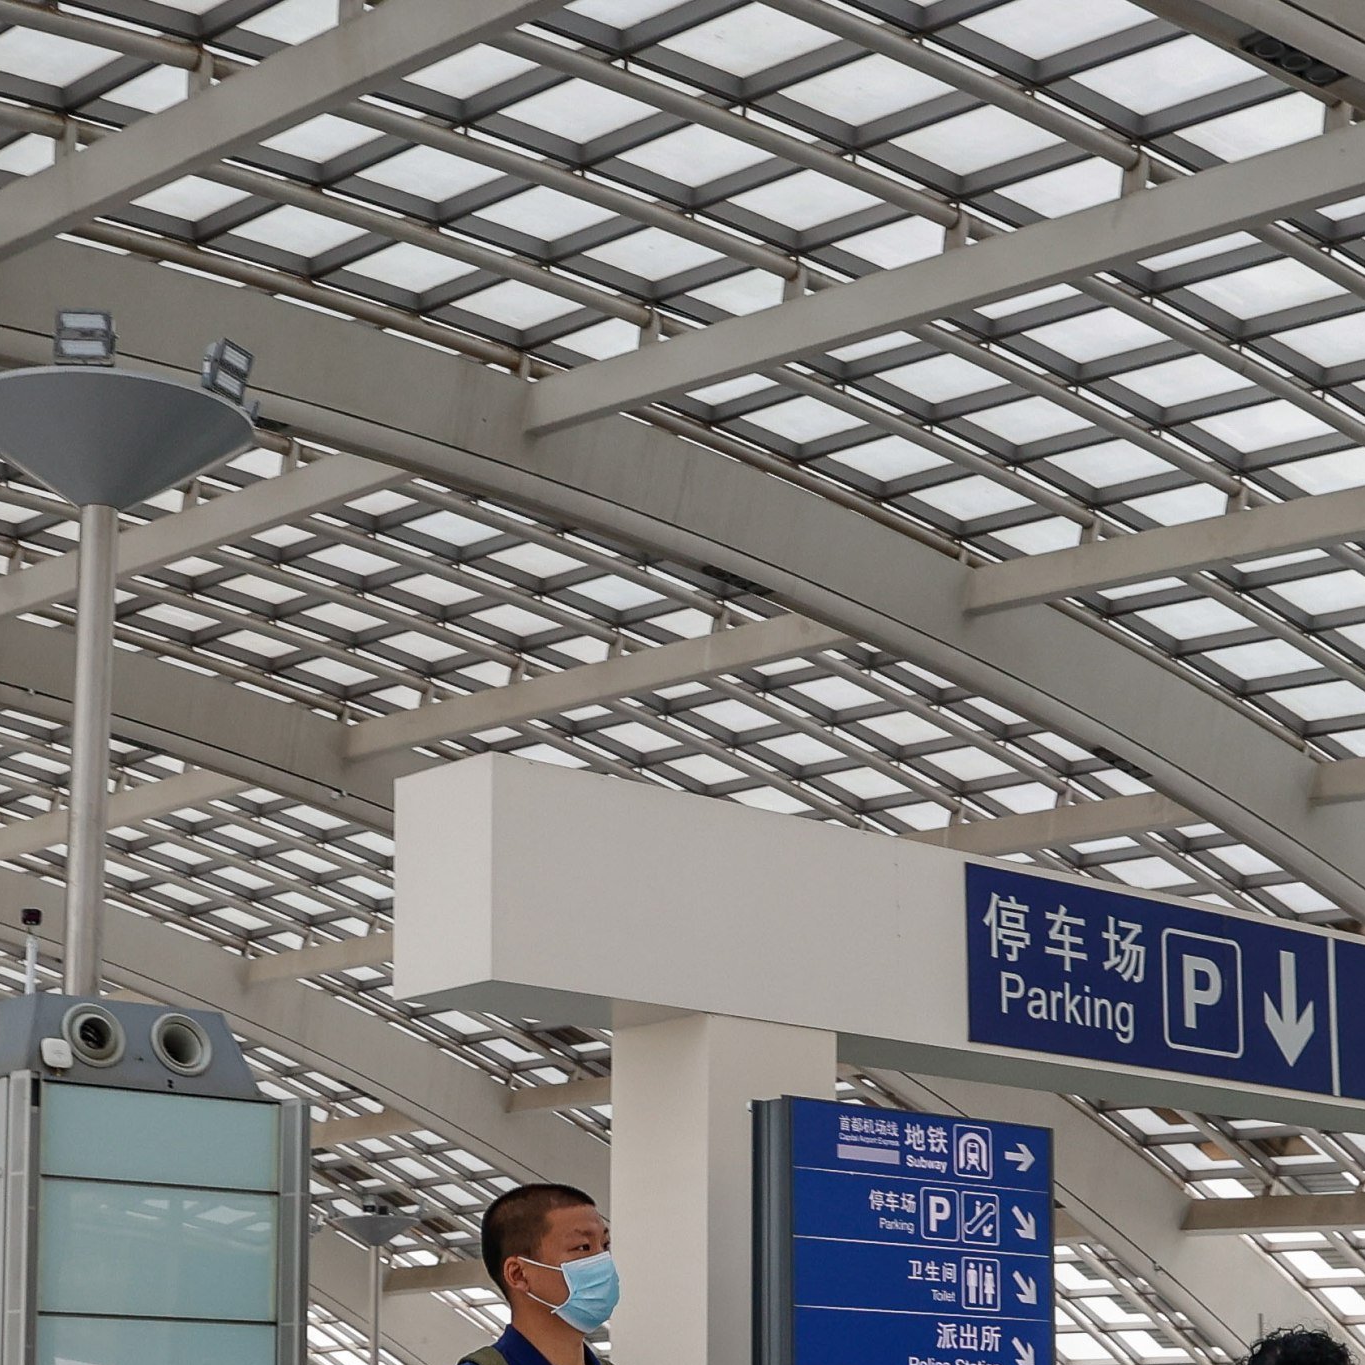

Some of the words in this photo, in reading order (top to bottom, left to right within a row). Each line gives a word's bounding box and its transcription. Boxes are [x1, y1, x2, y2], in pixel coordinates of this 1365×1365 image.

[983, 892, 1146, 984] 停车场
[1000, 972, 1136, 1045] Parking
[838, 1114, 900, 1138] 首都机场线
[904, 1123, 948, 1154] 地铁
[905, 1154, 948, 1174] Subway
[868, 1189, 917, 1214] 停车场
[879, 1217, 916, 1234] Parking
[907, 1259, 957, 1285] 卫生间
[930, 1289, 957, 1303] Toilet
[936, 1322, 1002, 1353] 派出所
